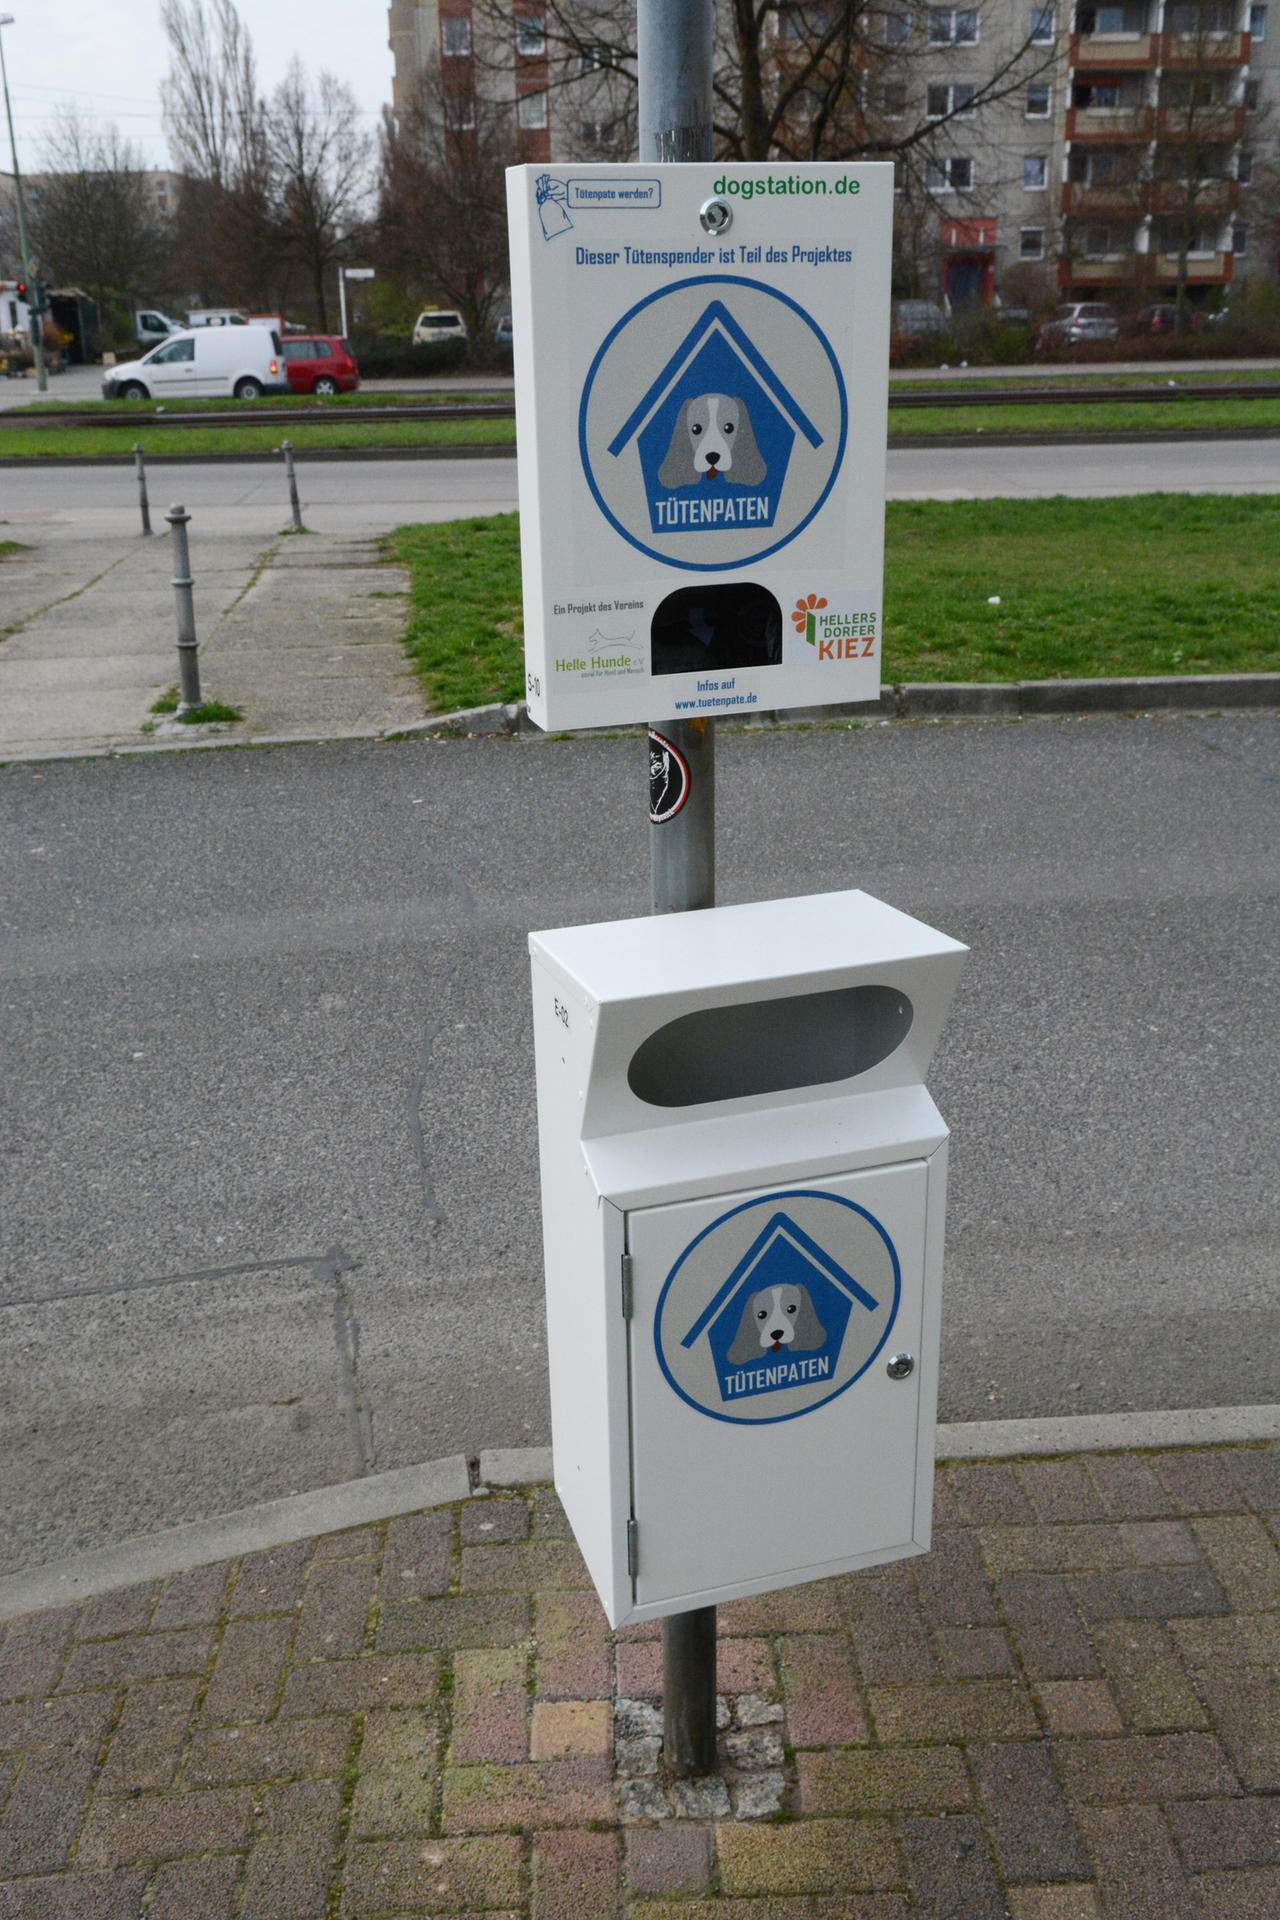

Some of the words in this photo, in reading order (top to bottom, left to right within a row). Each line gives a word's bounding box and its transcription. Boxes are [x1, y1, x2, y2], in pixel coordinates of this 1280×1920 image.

[574, 187, 616, 201] Tütenpate
[617, 186, 655, 200] werden?
[713, 175, 861, 200] dogstation.de
[575, 246, 620, 266] Dieser
[624, 245, 716, 268] Tütenspender
[718, 246, 736, 265] ist
[739, 245, 762, 264] Teil
[766, 245, 788, 264] des
[792, 245, 853, 267] Projektes
[655, 496, 769, 525] TÜTENPATEN
[553, 604, 566, 615] Ein
[567, 602, 596, 615] Projekt
[598, 602, 612, 611] des
[819, 612, 877, 626] HELLERS
[823, 624, 876, 638] DORFER
[818, 636, 876, 661] KIEZ
[554, 657, 587, 672] Helle
[591, 654, 632, 669] Hunde
[696, 679, 719, 692] Infos
[721, 677, 736, 690] auf
[675, 691, 758, 711] www.tuetenpate.de
[724, 1356, 829, 1394] TÜTENPATEN
